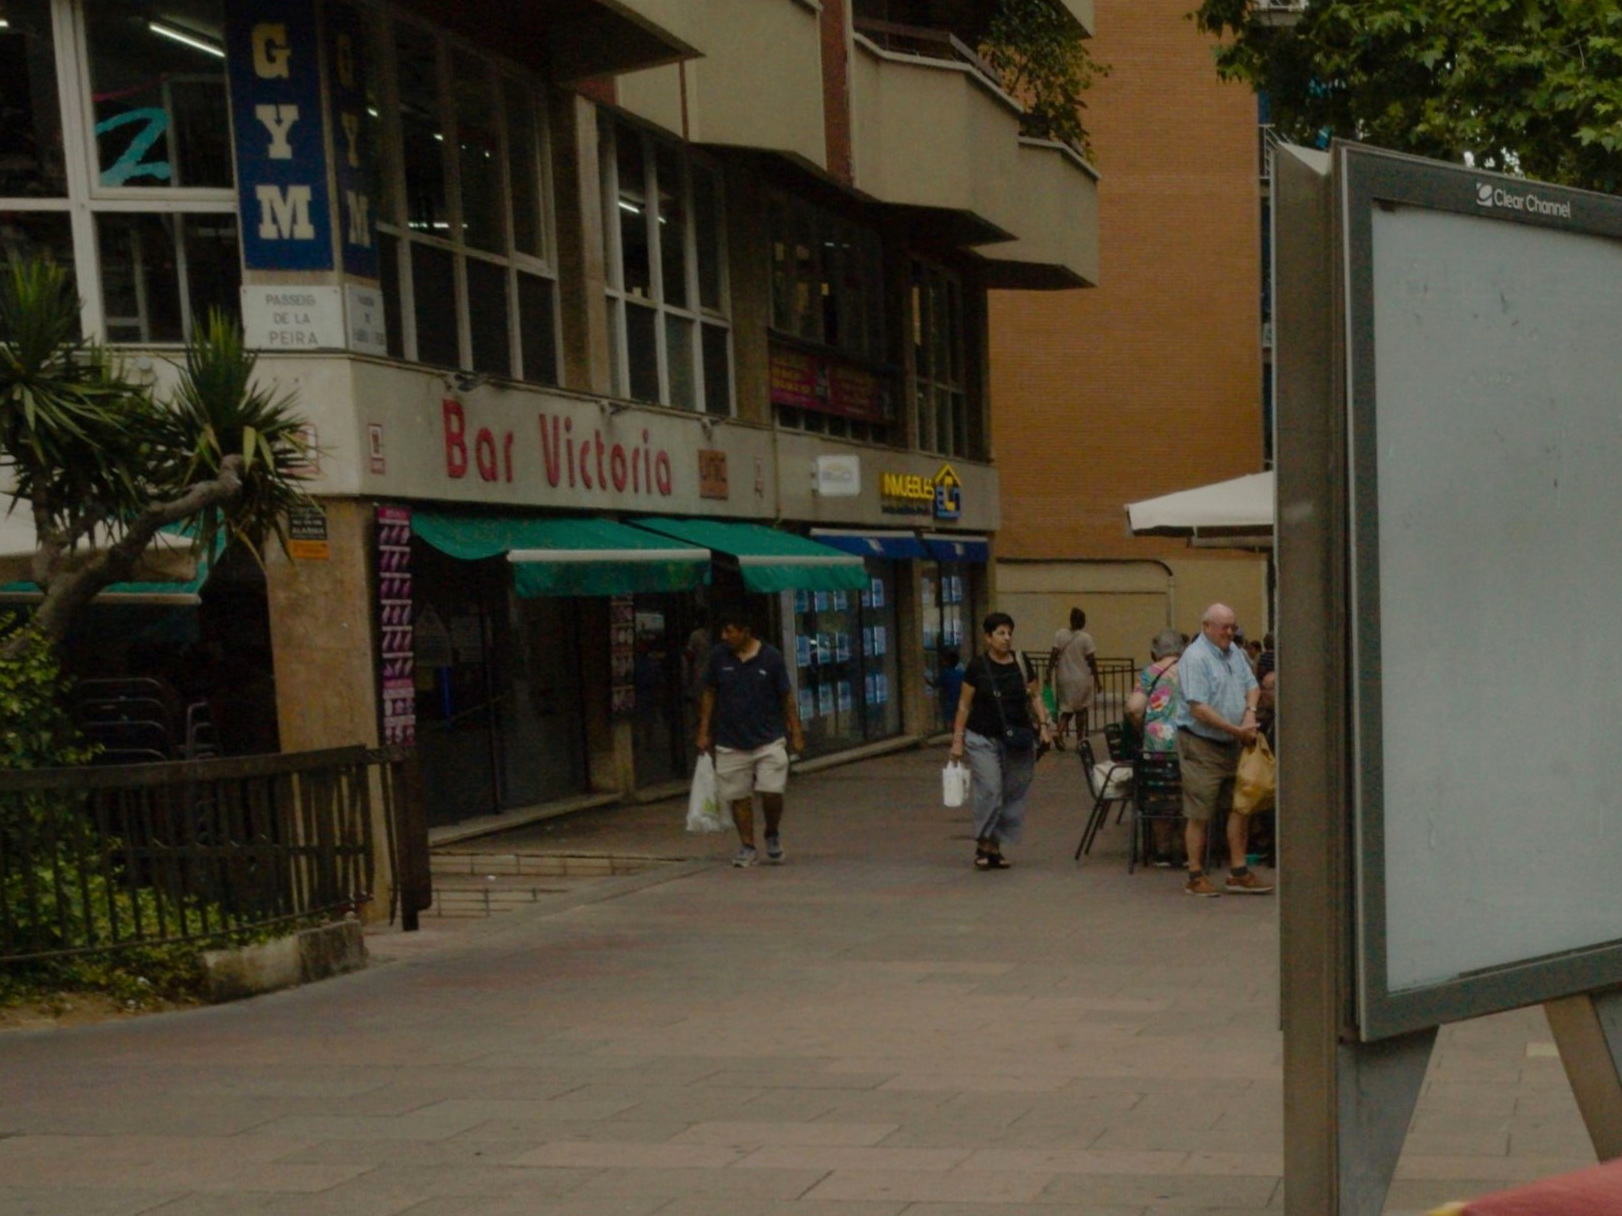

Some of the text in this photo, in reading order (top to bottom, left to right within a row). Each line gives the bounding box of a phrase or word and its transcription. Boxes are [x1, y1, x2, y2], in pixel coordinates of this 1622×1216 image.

[252, 21, 315, 240] GYM
[1494, 188, 1571, 218] Clear Channel
[265, 294, 317, 306] PASSEIG
[273, 312, 311, 324] DE LA
[269, 331, 318, 345] PEIRA
[442, 399, 672, 496] Bar Victoria
